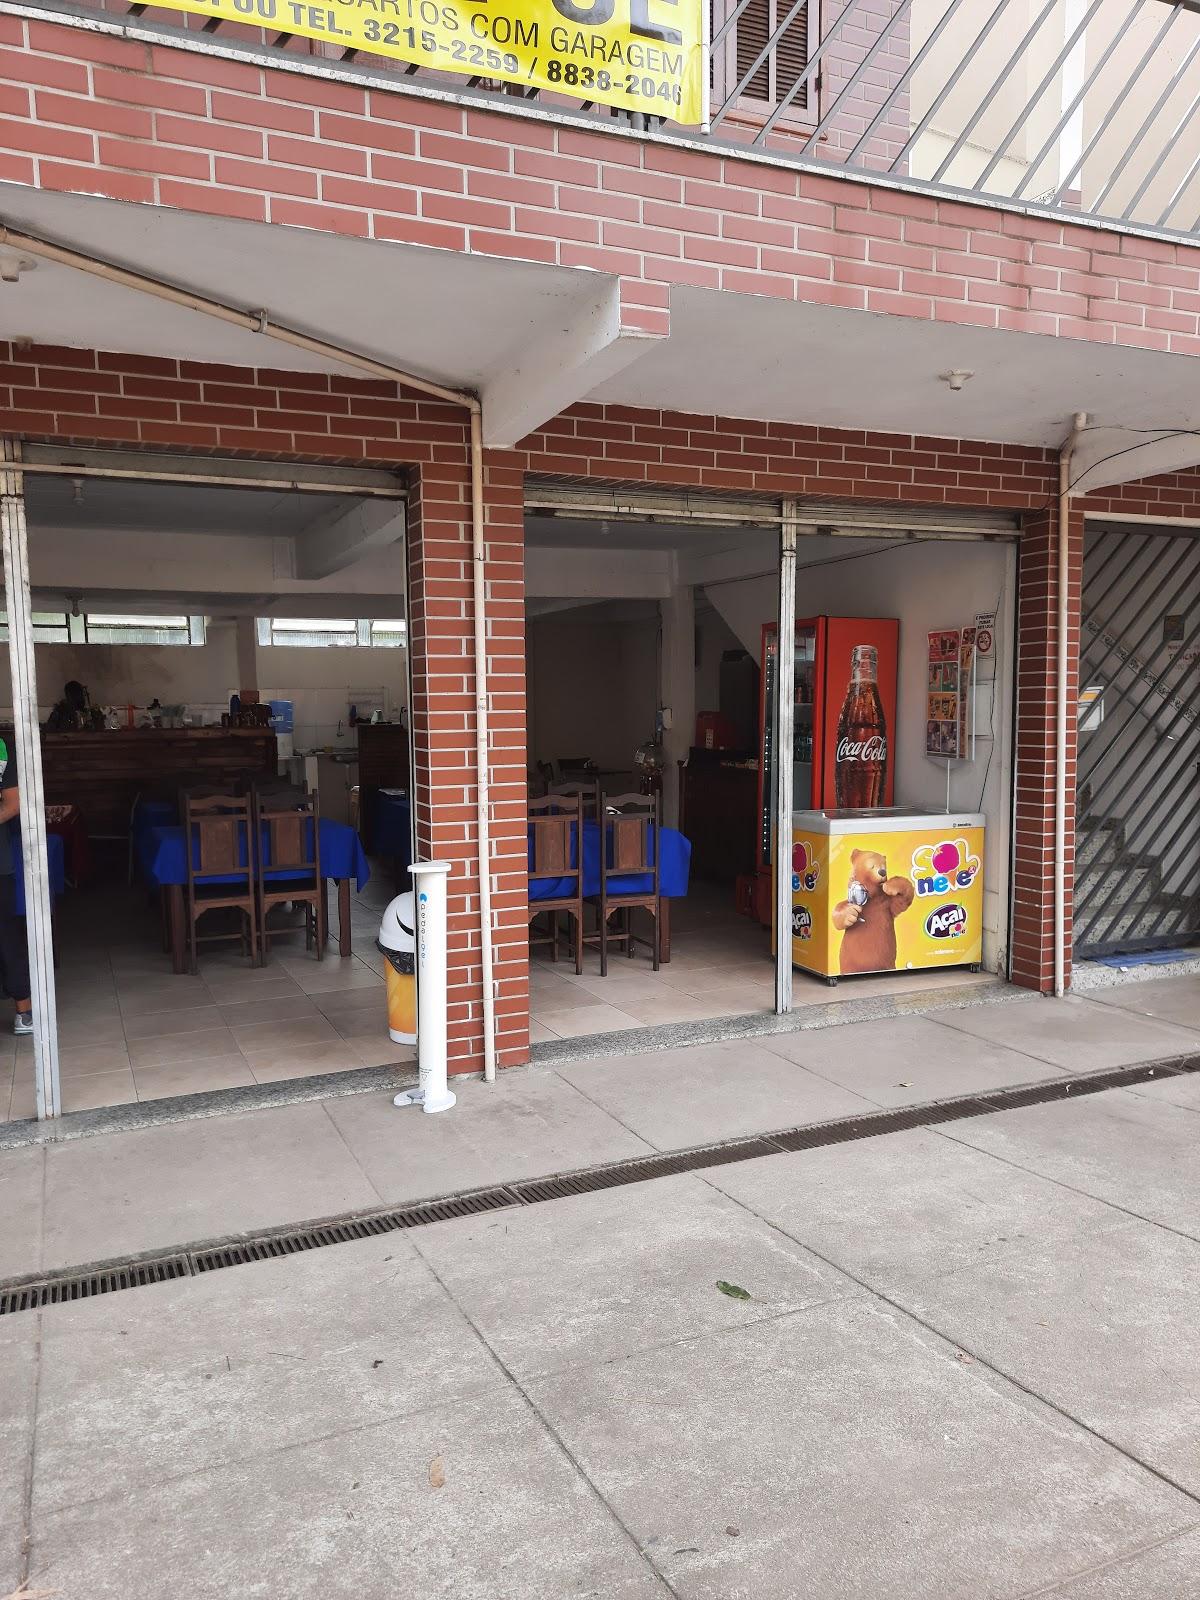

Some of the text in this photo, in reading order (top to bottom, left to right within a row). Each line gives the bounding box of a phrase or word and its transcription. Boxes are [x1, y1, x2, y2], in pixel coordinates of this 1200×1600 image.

[287, 2, 352, 36] TEL.
[363, 18, 519, 74] 3215-2259
[527, 57, 538, 79] /
[547, 60, 682, 106] 8838-2046
[470, 13, 539, 48] COM
[550, 27, 683, 76] GARAGEM
[836, 735, 887, 762] Coca-Cola
